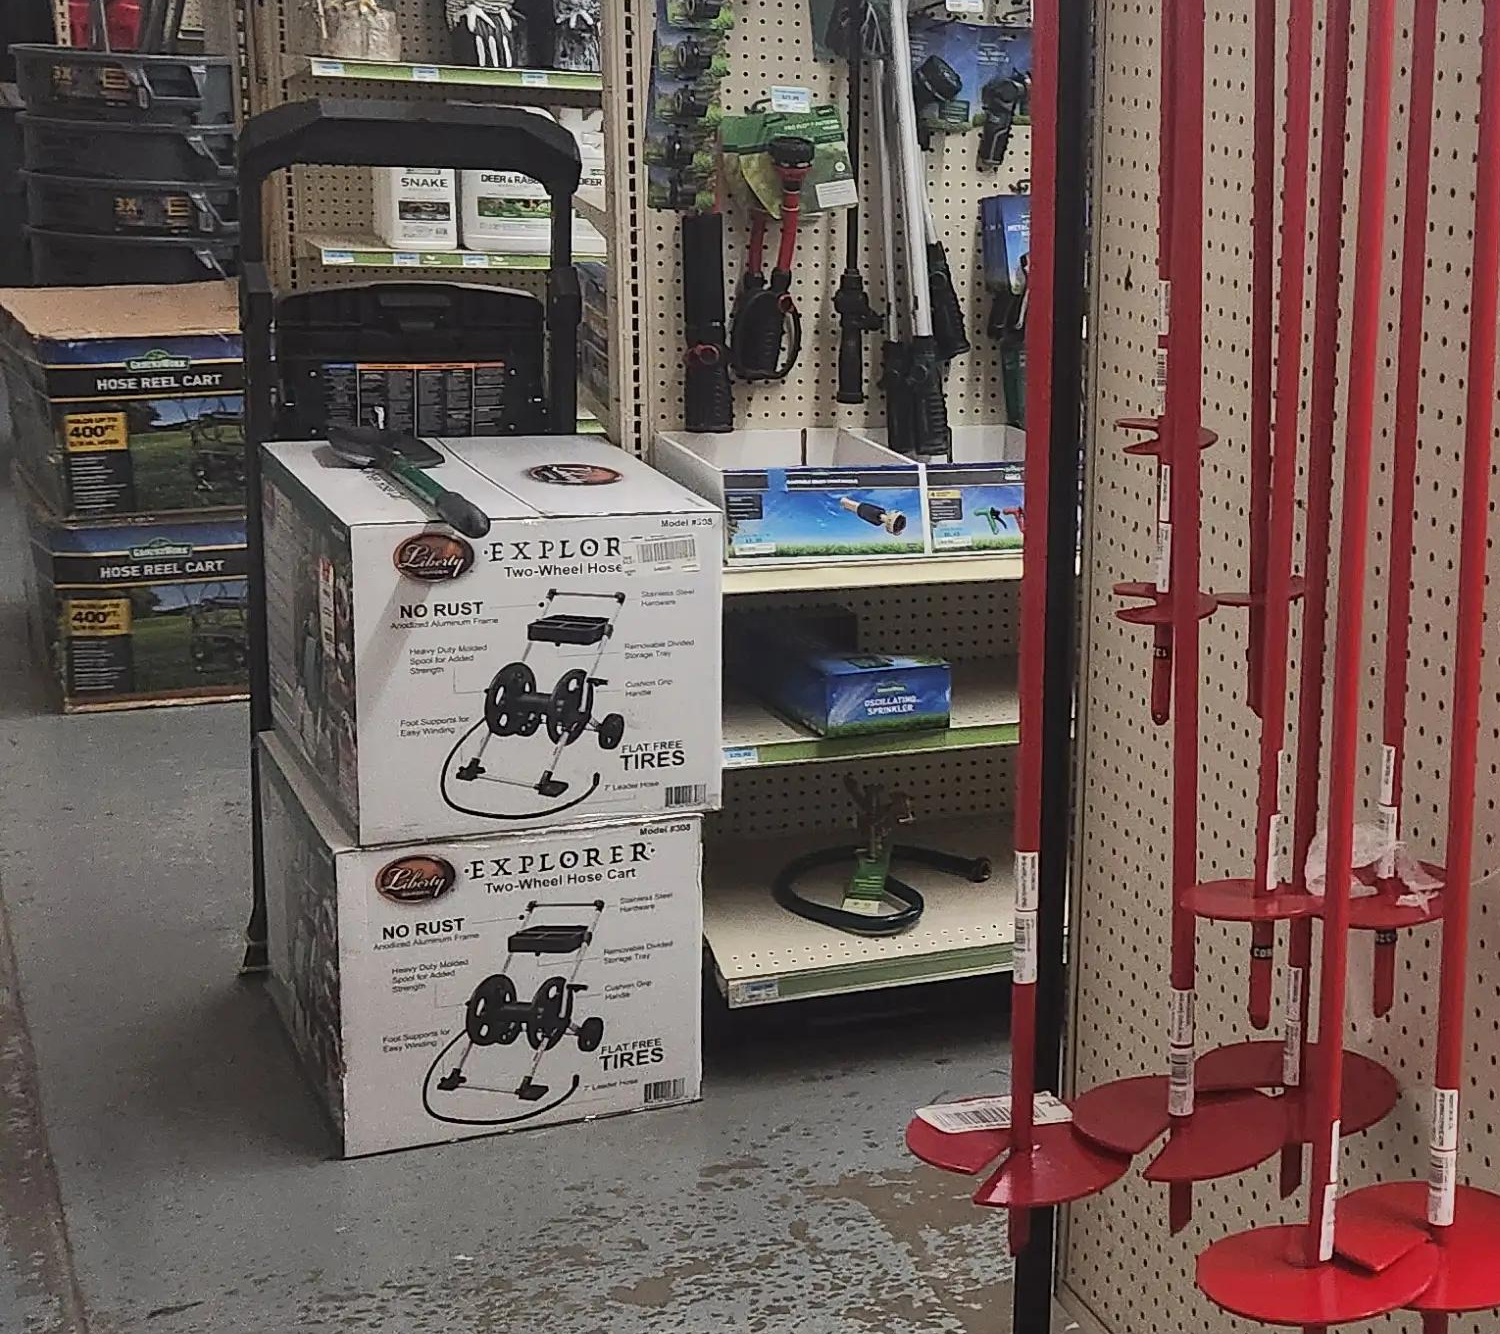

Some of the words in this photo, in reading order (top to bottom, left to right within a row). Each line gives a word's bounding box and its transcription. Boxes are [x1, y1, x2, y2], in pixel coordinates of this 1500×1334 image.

[400, 178, 449, 188] SNAKE
[480, 174, 507, 183] DEER
[97, 377, 138, 391] HOSE
[141, 376, 179, 388] REEL
[182, 374, 222, 386] CART
[661, 519, 688, 527] Model
[489, 537, 622, 562] EXPLOR
[399, 543, 464, 575] Liberty
[100, 566, 139, 578] HOSE
[143, 564, 182, 576] REEL
[185, 560, 225, 572] CART
[504, 562, 583, 578] Two-Wheel
[400, 604, 428, 618] NO
[434, 601, 484, 616] RUST
[71, 611, 107, 624] 400
[409, 647, 435, 656] Heavy
[437, 646, 456, 655] Duty
[447, 655, 474, 663] Added
[864, 696, 917, 707] OSCILLATING
[867, 704, 914, 715] SPRINKLER
[400, 729, 420, 738] Easy
[422, 727, 455, 736] Winding
[621, 742, 649, 753] FLAT
[653, 740, 684, 750] FREE
[620, 750, 685, 770] TIRES
[640, 825, 669, 836] Model
[468, 842, 650, 880] EXPLORER
[387, 868, 445, 897] Liberty
[484, 875, 563, 895] Two-Wheel
[567, 873, 602, 886] Hose
[607, 867, 636, 880] Cart
[382, 924, 409, 940] NO
[415, 917, 465, 936] RUST
[454, 933, 480, 941] Frame
[418, 963, 437, 972] Duty
[429, 970, 456, 979] Added
[383, 1044, 403, 1053] Easy
[405, 1040, 437, 1050] Winding
[601, 1043, 629, 1055] FLAT
[631, 1038, 662, 1050] FREE
[599, 1047, 664, 1071] TIRES
